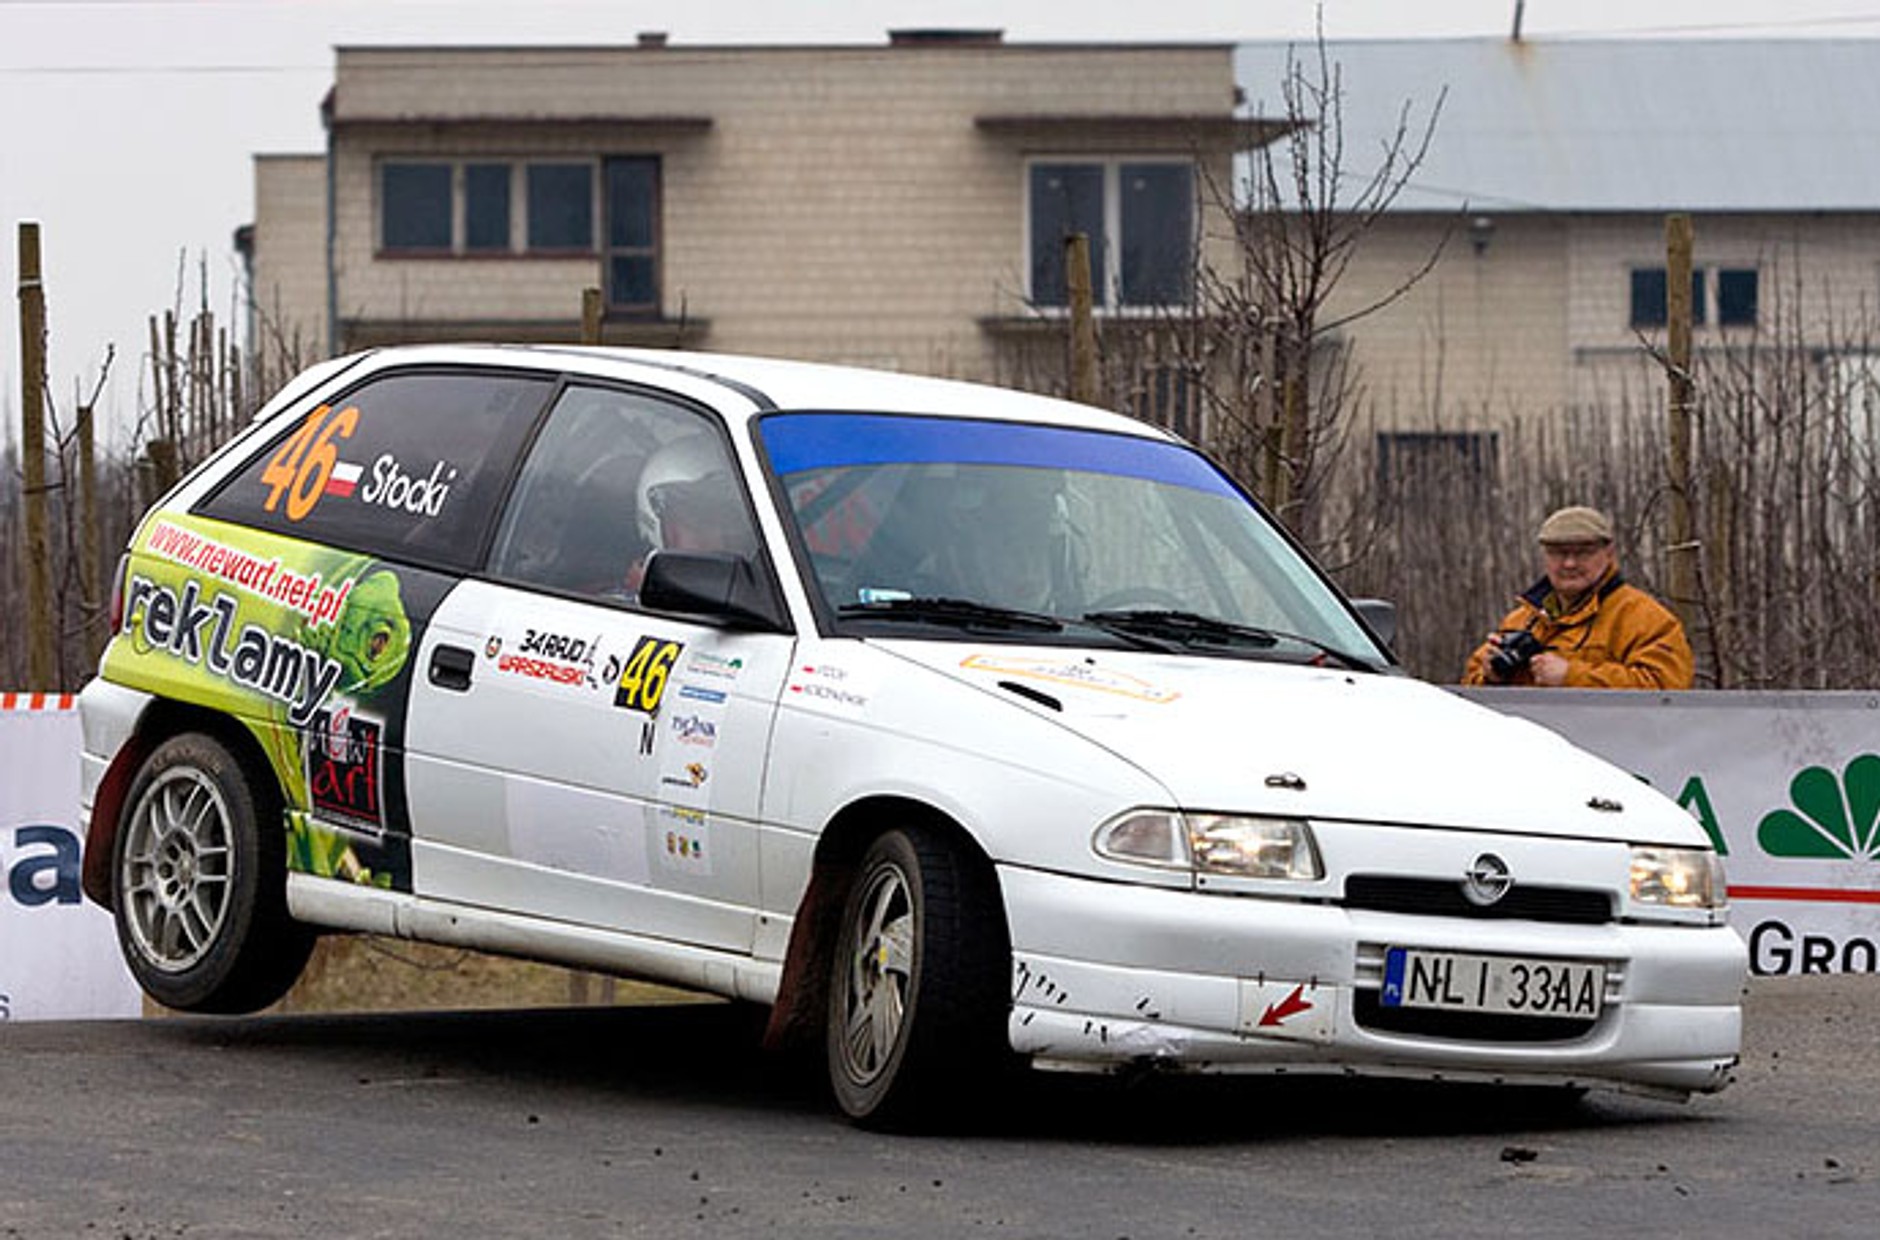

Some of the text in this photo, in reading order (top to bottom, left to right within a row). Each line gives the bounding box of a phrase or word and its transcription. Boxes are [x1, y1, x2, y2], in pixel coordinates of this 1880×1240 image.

[261, 403, 456, 521] 46 Stocki
[149, 522, 351, 626] www.newart.net.pl
[125, 576, 341, 725] reklamy
[619, 639, 680, 710] 46
[312, 729, 377, 811] art
[640, 721, 656, 755] N
[8, 824, 82, 906] a
[1508, 964, 1596, 1014] 33AA
